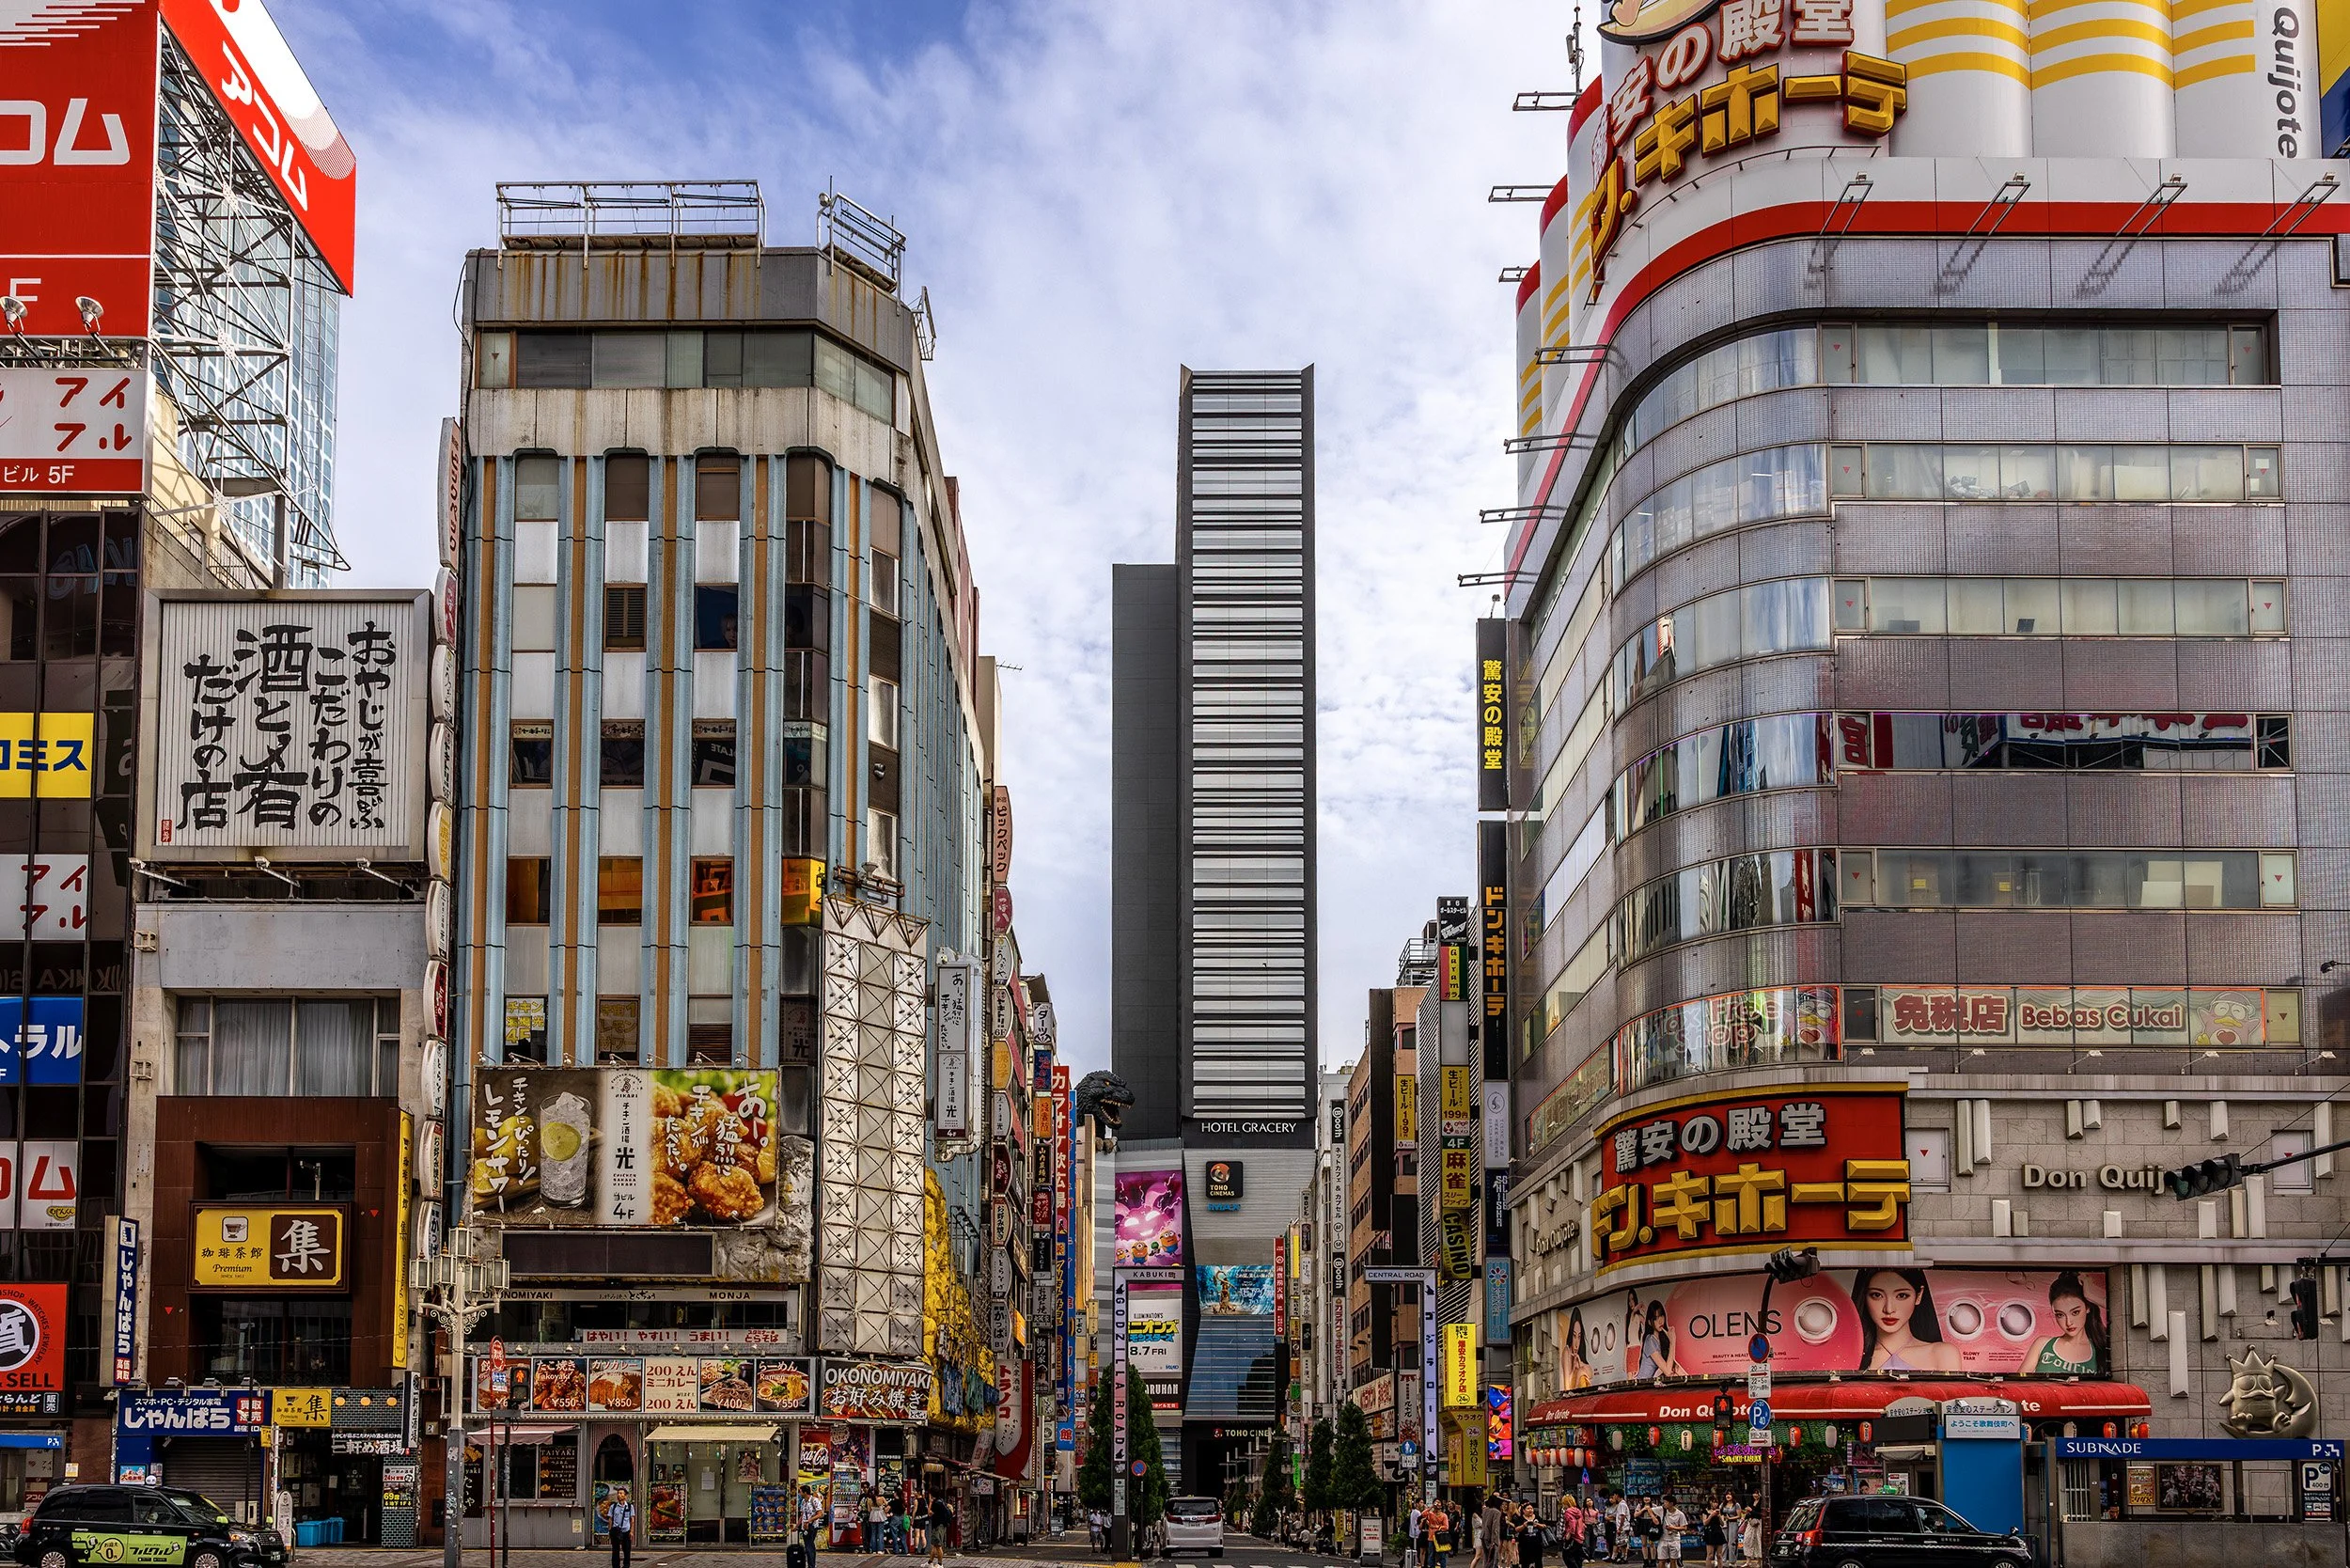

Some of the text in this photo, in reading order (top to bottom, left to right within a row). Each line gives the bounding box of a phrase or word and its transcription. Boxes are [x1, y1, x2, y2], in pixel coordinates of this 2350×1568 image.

[2266, 6, 2299, 158] Quijote
[221, 41, 308, 212] アコム
[55, 377, 131, 409] アイ
[54, 423, 133, 452] フル
[48, 465, 74, 483] 5F
[1482, 659, 1503, 770] 驚安の殿堂
[176, 653, 241, 830] だけの店
[308, 648, 352, 827] こだわりの
[21, 864, 86, 893] アイ
[507, 1000, 543, 1014] チキン
[1892, 994, 2183, 1035] 免税店 Bebas Cukai
[1039, 1010, 1049, 1037] ダーツ
[1448, 1070, 1458, 1107] 生ビール
[689, 1085, 712, 1148] チキンが
[946, 1105, 957, 1118] 光
[1443, 1110, 1468, 1119] 199円
[1201, 1121, 1297, 1133] HOTEL GRACERY
[484, 1083, 510, 1214] レモンサワー
[1447, 1137, 1465, 1148] 4F
[1614, 1103, 1826, 1174] 驚安の殿堂
[615, 1146, 635, 1169] 光
[1446, 1152, 1466, 1190] 麻雀
[2022, 1164, 2089, 1189] Don
[613, 1192, 635, 1201] 当ビル
[613, 1202, 634, 1219] 4F
[274, 1219, 331, 1274] 集
[1443, 1212, 1471, 1275] CASINO
[212, 1263, 252, 1273] Premium
[709, 1291, 751, 1299] MONJA
[27, 1298, 50, 1330] WATCHES
[689, 1330, 729, 1341] うまい!
[1689, 1309, 1782, 1341] OLENS
[33, 1331, 50, 1365] JEWELRY
[1130, 1346, 1151, 1356] 8.7
[537, 1359, 575, 1372] たこ焼き
[592, 1359, 639, 1370] カツカレー
[647, 1365, 697, 1376] 200 えん
[759, 1360, 798, 1372] らーめん
[1116, 1297, 1125, 1445] GODZILLA ROAD
[7, 1372, 55, 1388] SELL
[537, 1372, 572, 1383] Takoyaki
[646, 1378, 697, 1388] ミニカレー
[825, 1368, 932, 1389] OKONOMIYAKI
[830, 1387, 924, 1410] お好み焼き
[998, 1364, 1011, 1419] トラノコ
[303, 1394, 327, 1421] 集
[647, 1399, 697, 1409] 200 えん
[1659, 1405, 1691, 1418] Don
[124, 1406, 230, 1430] じゃんぱら
[1456, 1413, 1483, 1421] カラオケ
[1753, 1406, 1762, 1425] P
[1950, 1419, 2015, 1428] ようこそ歌舞伎町へ
[1059, 1428, 1073, 1440] 館
[2067, 1442, 2141, 1454] SUBNADE
[2312, 1444, 2322, 1456] P
[2305, 1467, 2315, 1489] P
